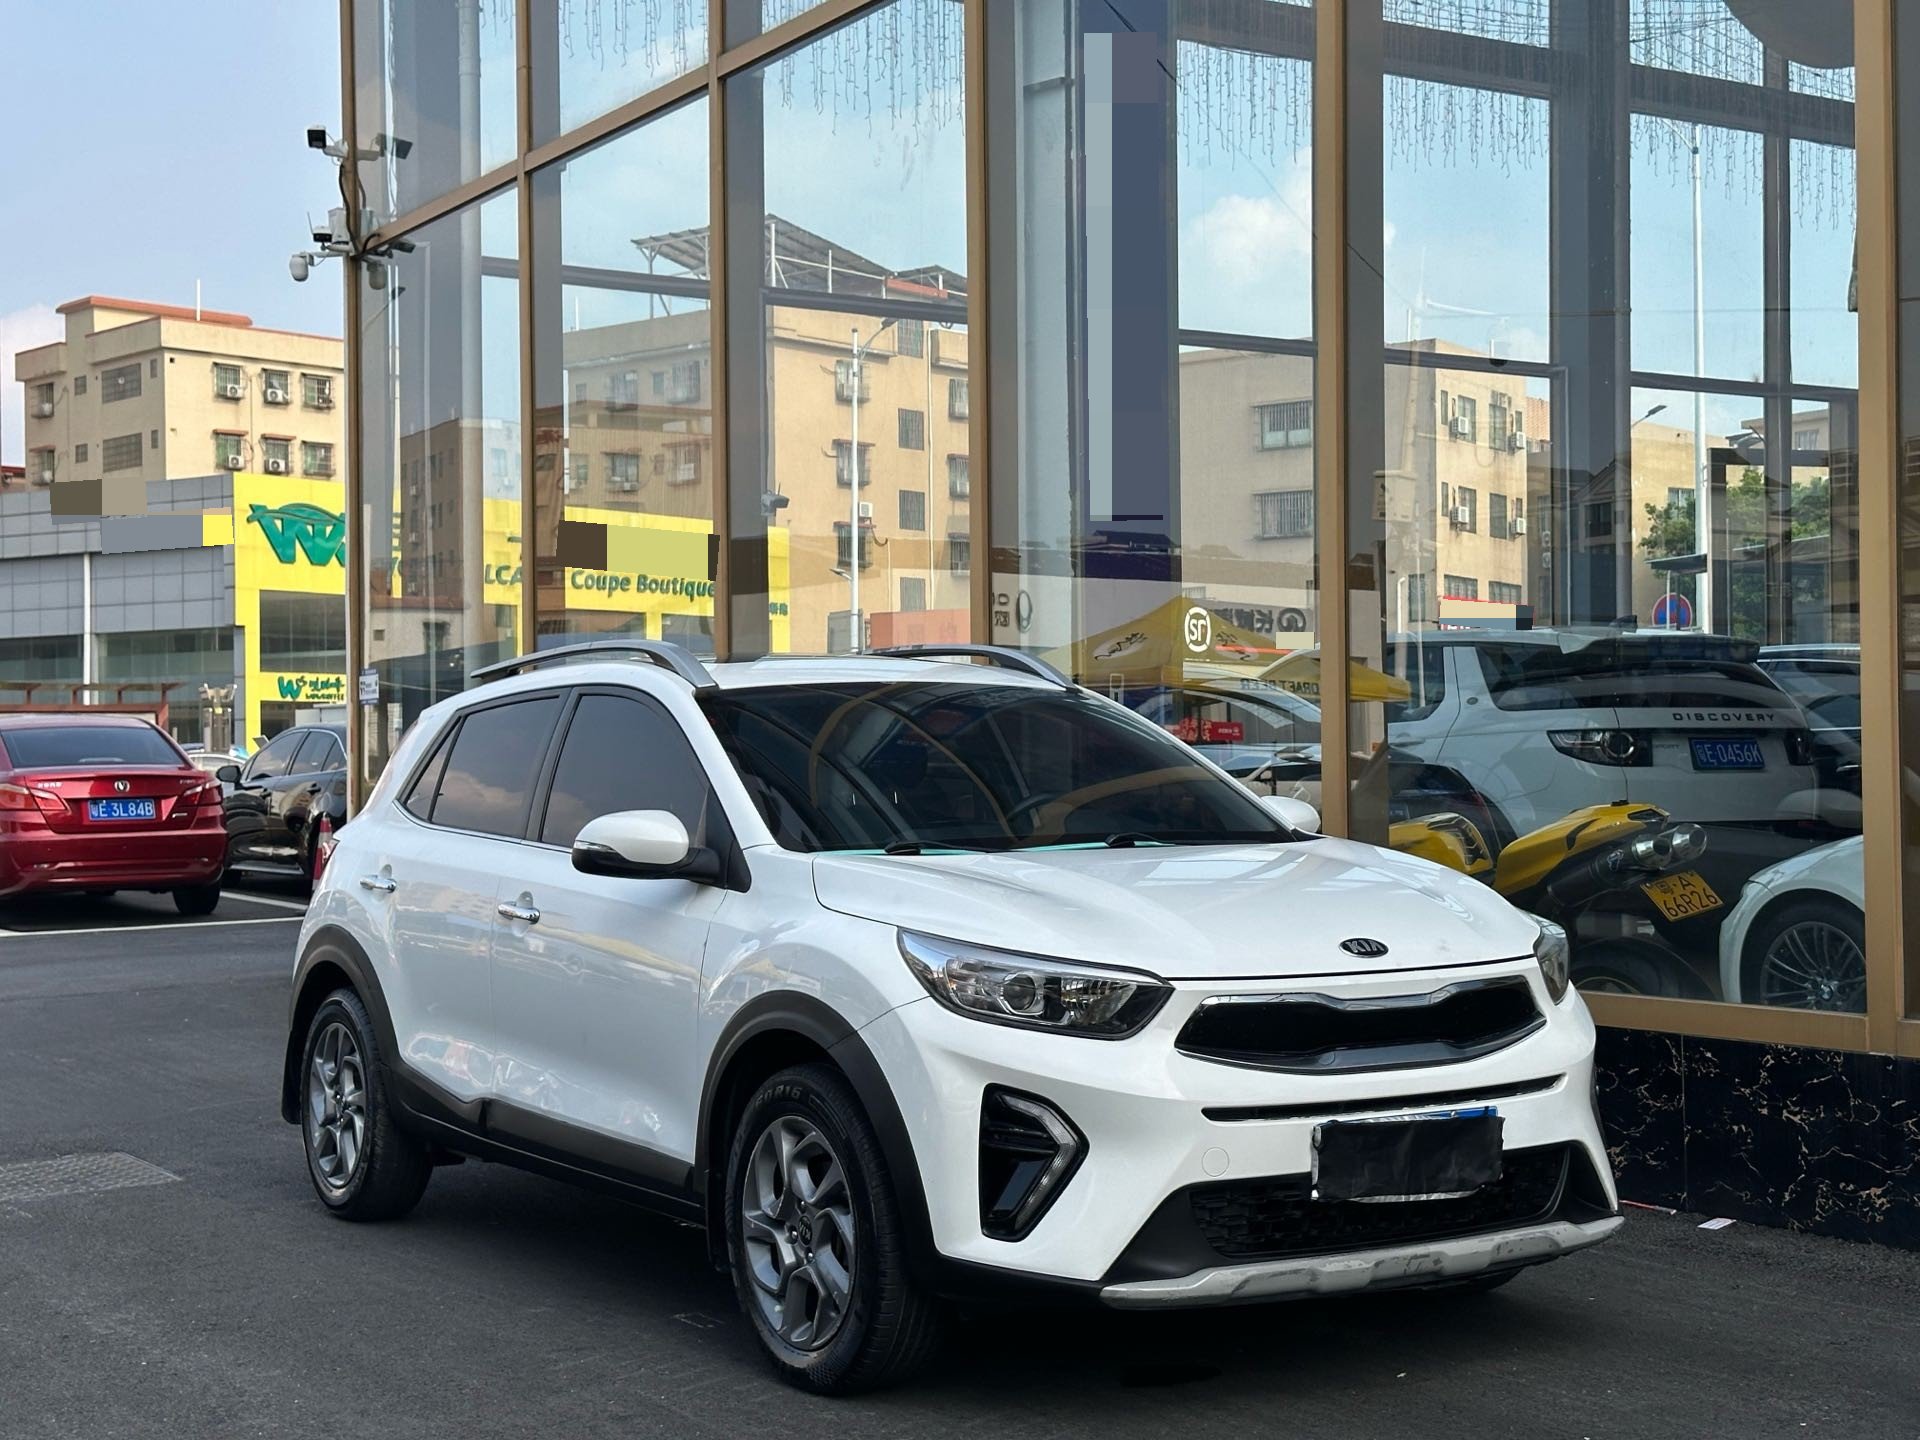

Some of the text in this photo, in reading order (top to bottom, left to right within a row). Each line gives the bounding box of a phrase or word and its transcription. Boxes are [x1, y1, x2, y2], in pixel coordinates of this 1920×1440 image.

[571, 570, 715, 602] Coupe Boutique
[1672, 712, 1775, 721] DISCOVERY
[1663, 888, 1718, 917] 66R26
[1345, 940, 1385, 953] KIA
